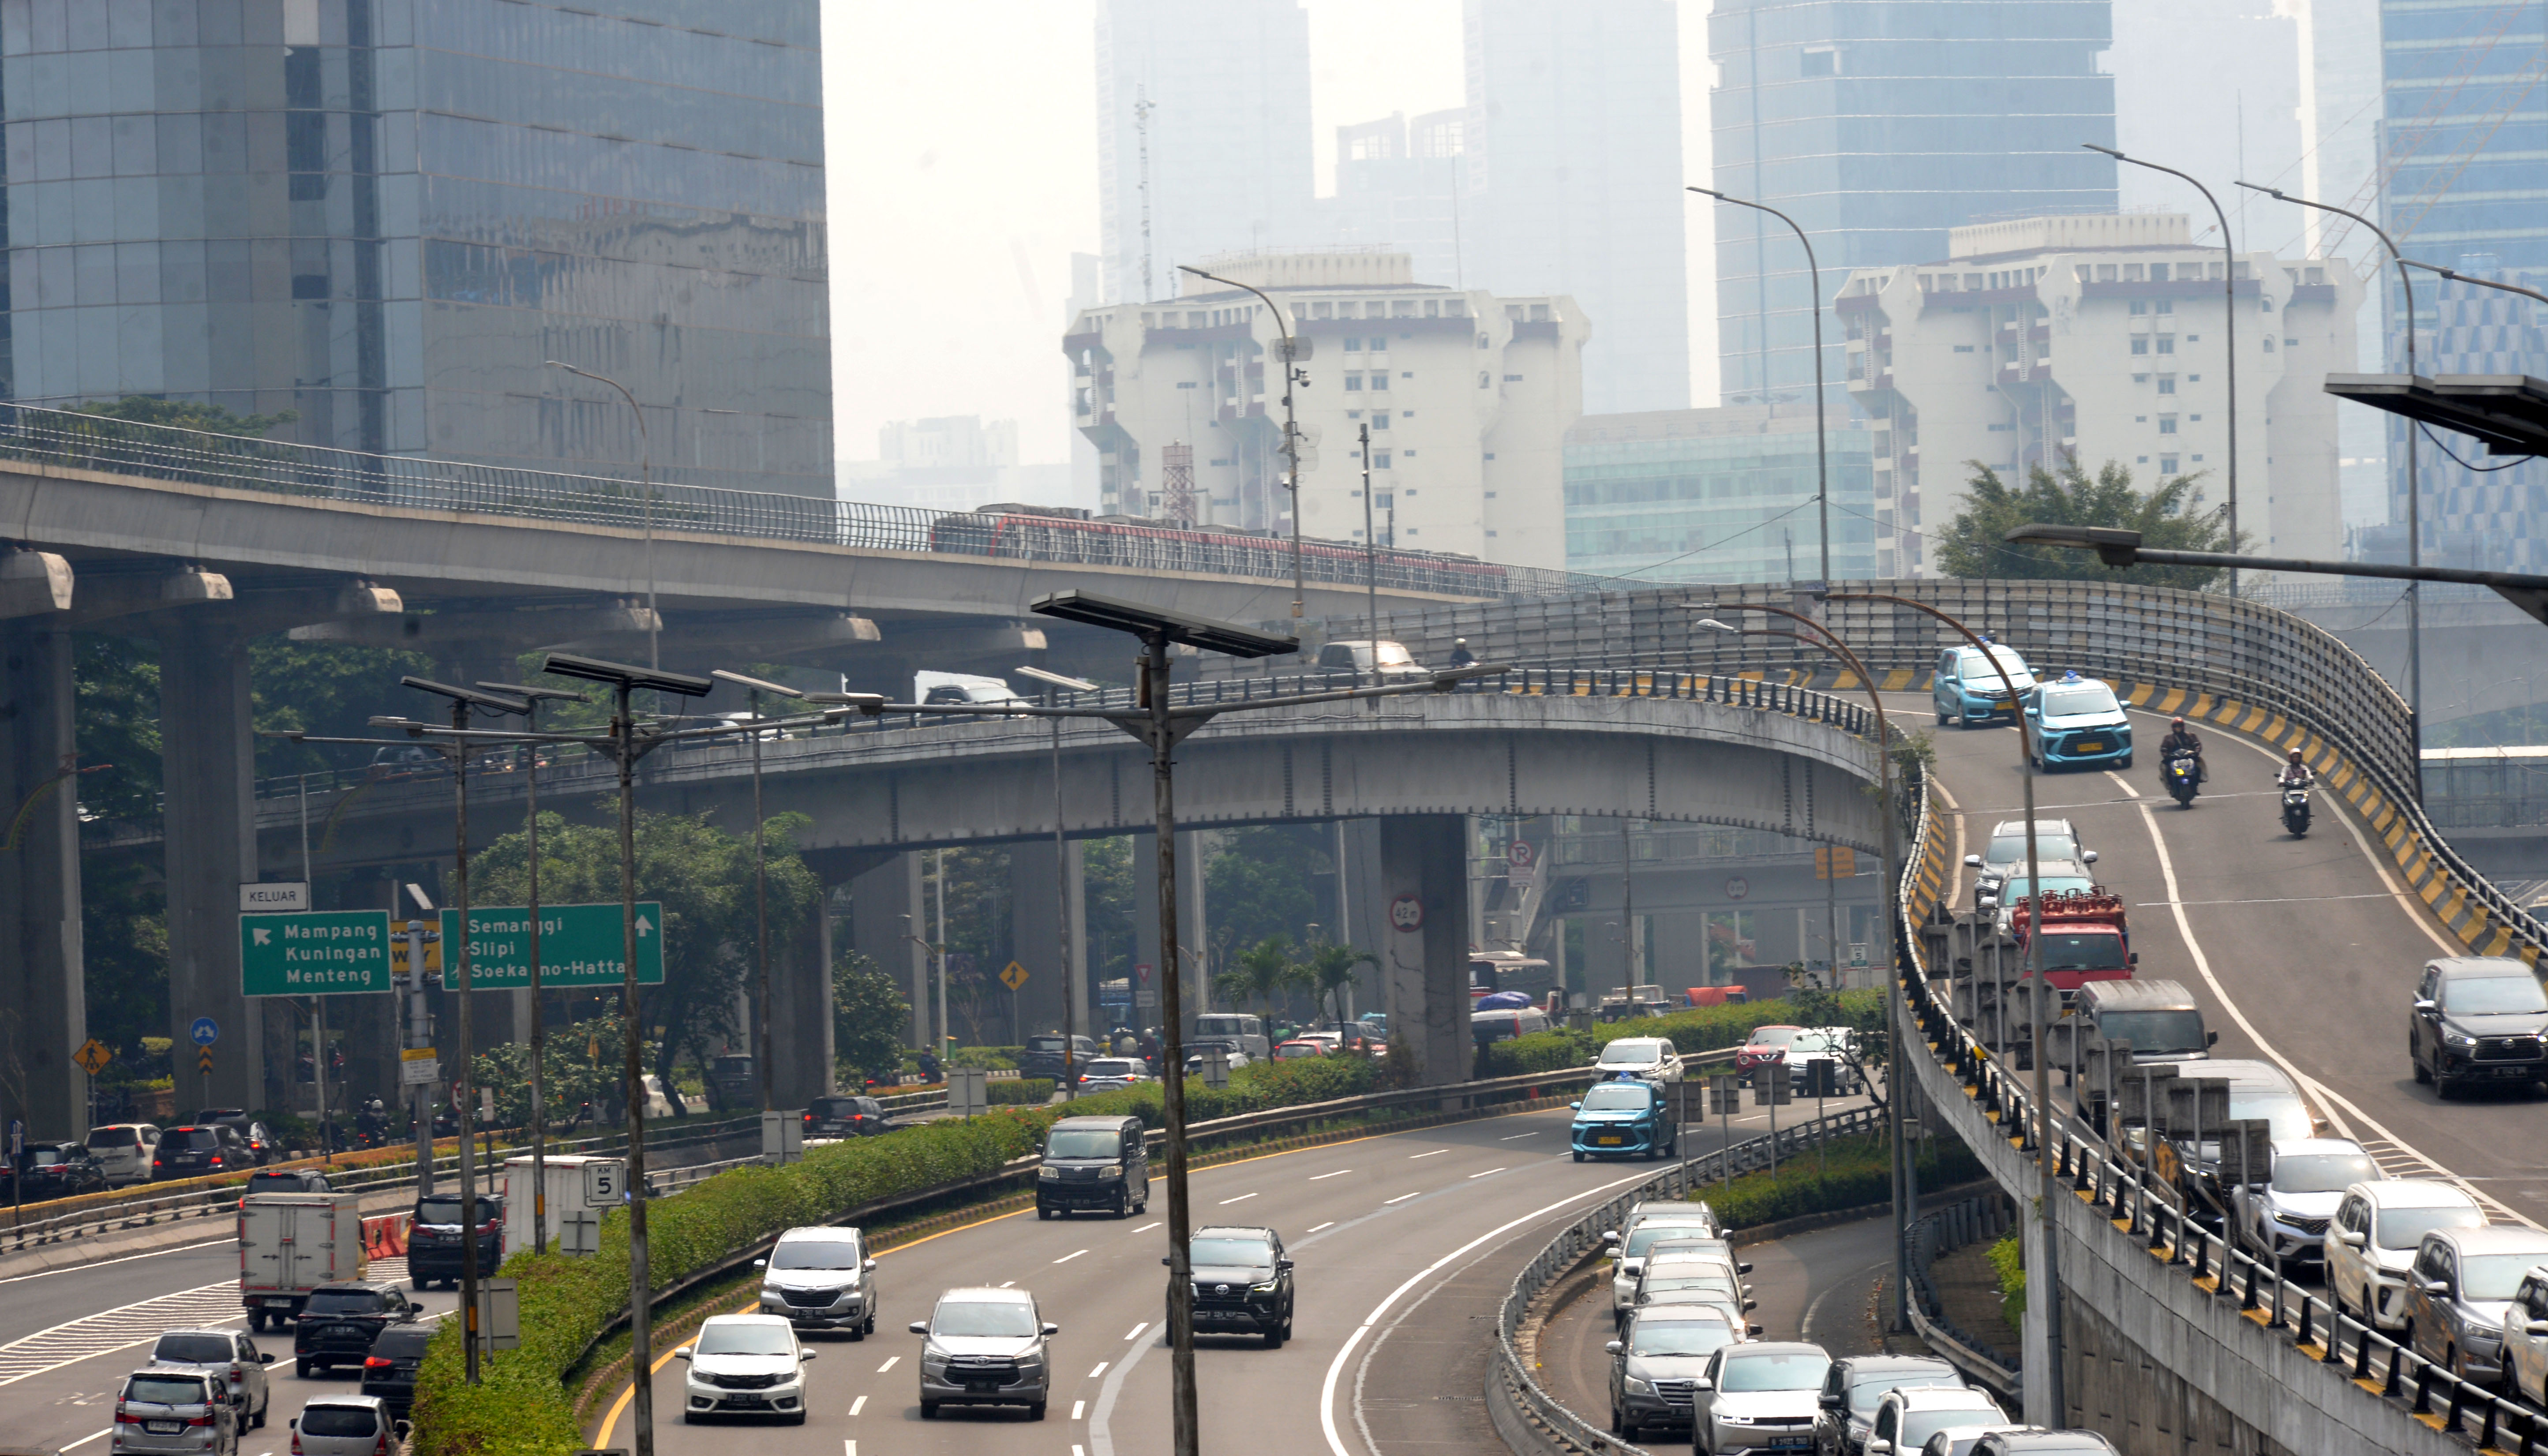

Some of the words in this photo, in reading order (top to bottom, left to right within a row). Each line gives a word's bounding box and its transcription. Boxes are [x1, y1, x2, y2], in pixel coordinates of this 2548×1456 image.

[249, 891, 296, 902] KELUAR
[284, 924, 377, 940] Mampang
[286, 946, 381, 963] Kuningan
[469, 941, 515, 958] Slipi
[286, 969, 371, 985] Menteng
[471, 960, 625, 978] Soekano-Hatta
[597, 1177, 611, 1195] 5
